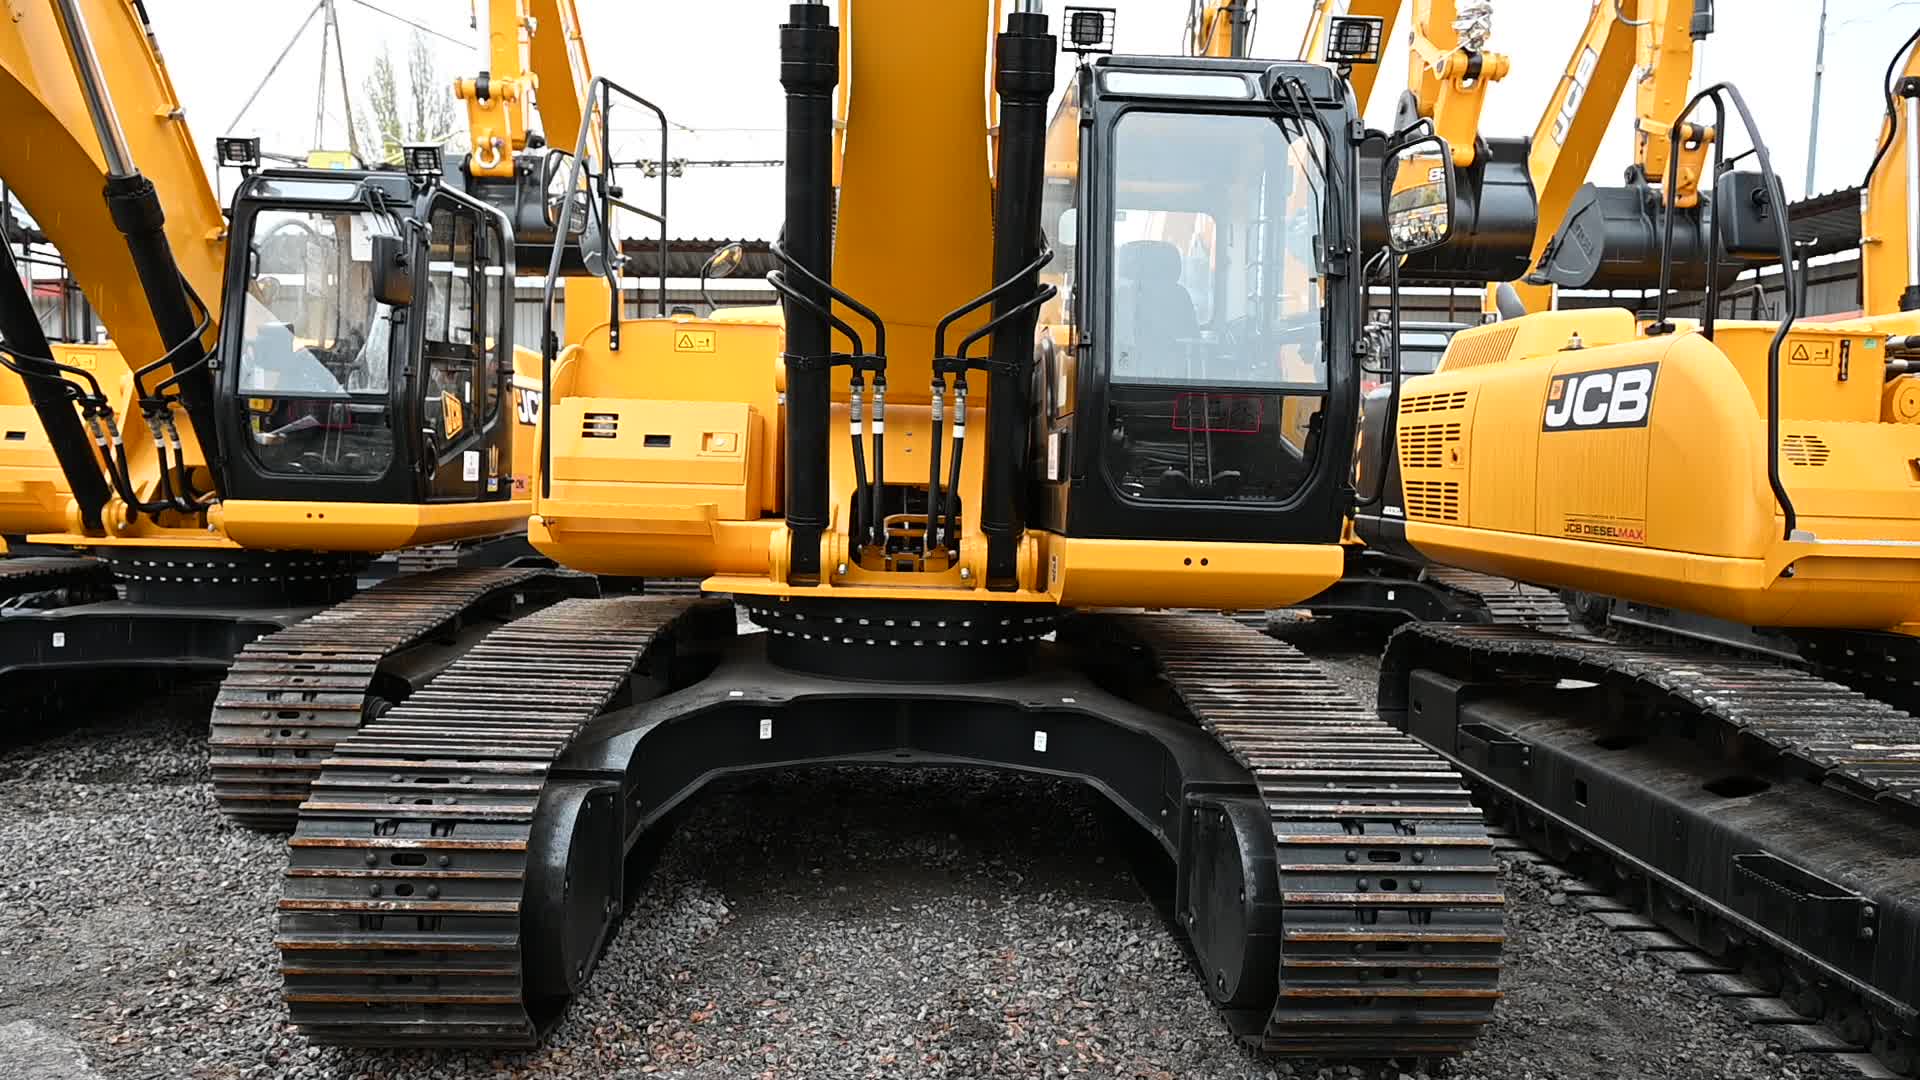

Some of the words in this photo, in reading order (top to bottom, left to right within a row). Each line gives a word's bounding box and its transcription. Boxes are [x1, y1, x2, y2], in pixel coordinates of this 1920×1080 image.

[1553, 46, 1598, 147] JCB
[1545, 368, 1652, 427] JCB
[1564, 523, 1582, 534] JCB
[1583, 524, 1643, 540] DIESELMAX
